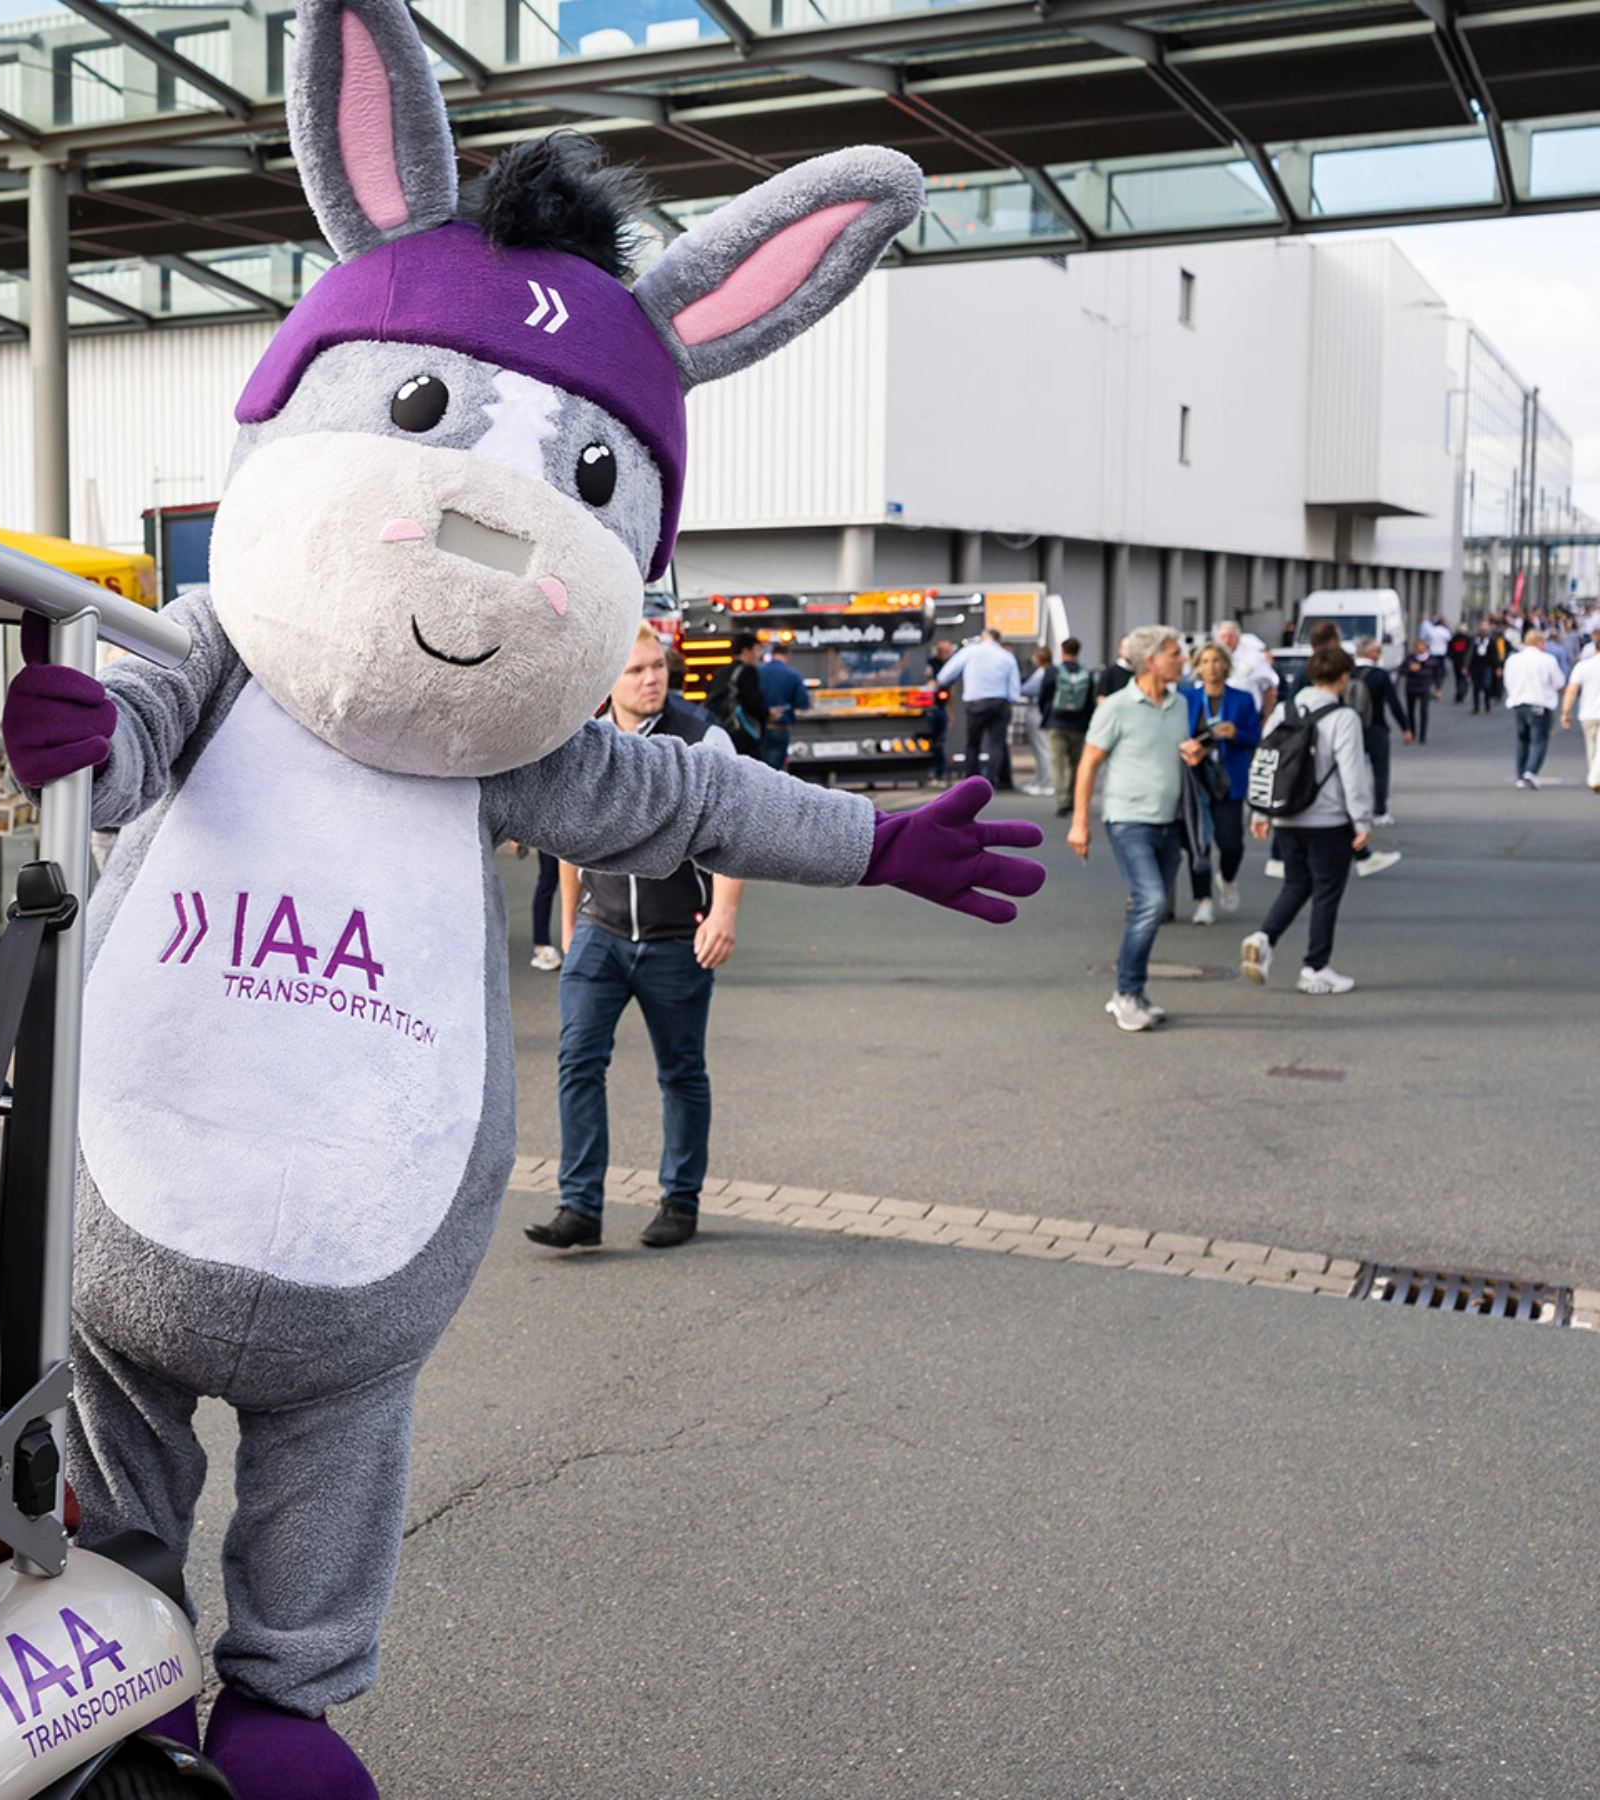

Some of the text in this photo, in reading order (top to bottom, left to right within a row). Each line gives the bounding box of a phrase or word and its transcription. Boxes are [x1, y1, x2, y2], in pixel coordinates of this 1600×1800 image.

[231, 892, 384, 991] IAA
[223, 974, 438, 1046] TRANSPORTATION
[22, 1654, 184, 1758] TRANSPORTATION
